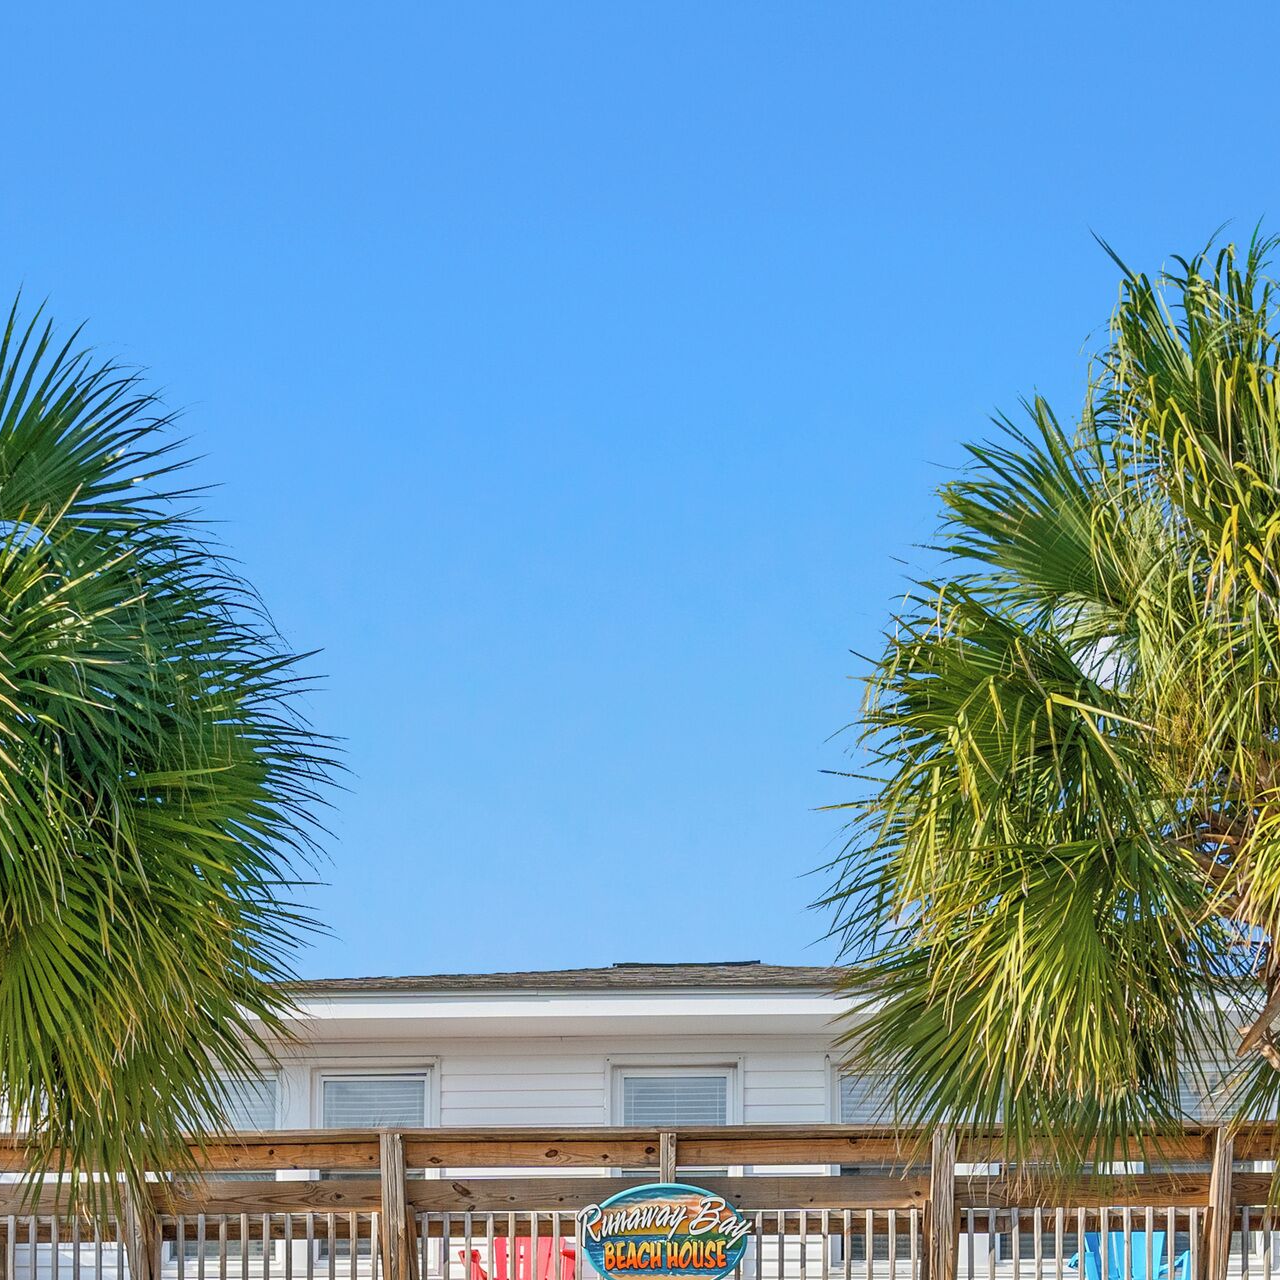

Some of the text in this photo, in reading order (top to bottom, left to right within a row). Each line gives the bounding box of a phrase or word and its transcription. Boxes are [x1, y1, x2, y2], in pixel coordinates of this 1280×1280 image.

[577, 1196, 753, 1249] Runaway Bay
[604, 1239, 727, 1271] BEACH HOUSE
